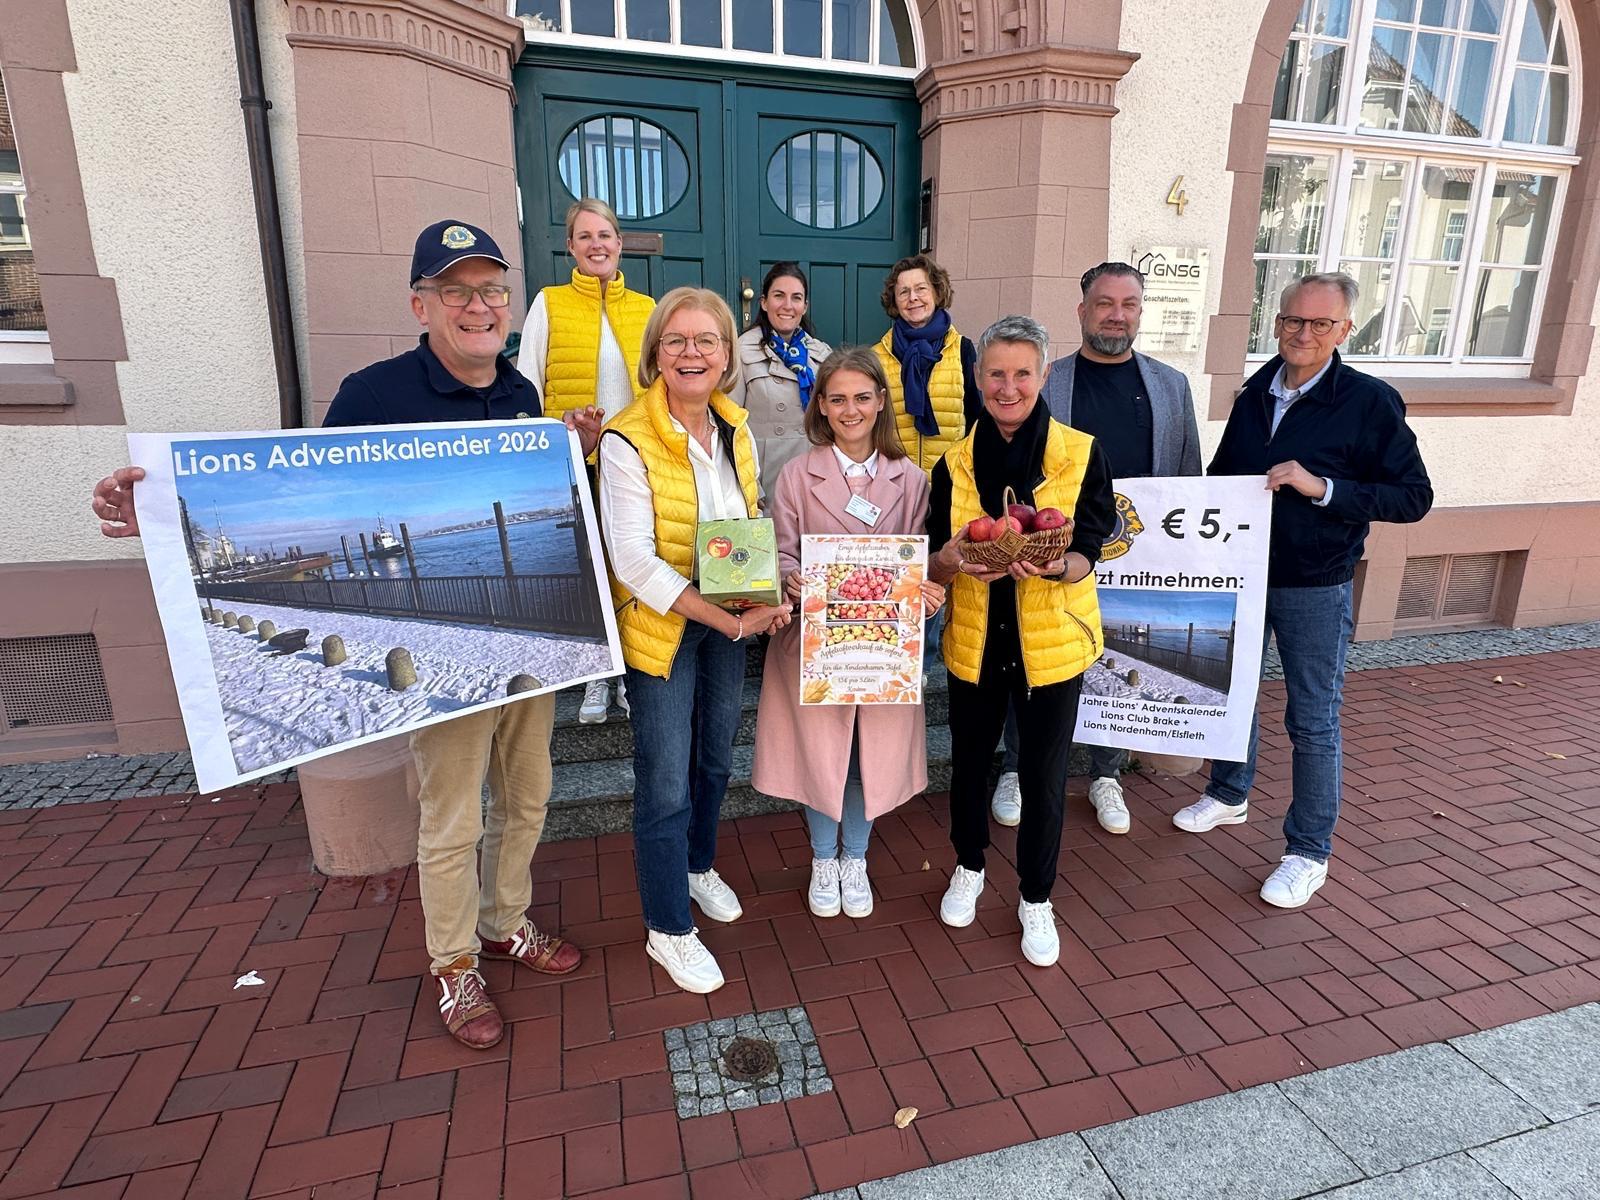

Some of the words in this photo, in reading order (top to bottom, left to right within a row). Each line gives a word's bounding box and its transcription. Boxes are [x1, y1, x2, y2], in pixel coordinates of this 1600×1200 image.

[1166, 175, 1188, 216] 4
[1154, 264, 1200, 278] GNSG
[174, 447, 257, 476] Lions
[267, 434, 493, 469] Adventskalender
[497, 430, 550, 454] 2026
[1161, 508, 1186, 539] €
[1120, 571, 1245, 589] mitnehmen:
[1082, 697, 1109, 708] Jahre
[1141, 703, 1227, 718] Adventskalender
[1101, 710, 1125, 721] Lions
[1127, 713, 1151, 723] Club
[1153, 717, 1181, 726] Brake
[1083, 720, 1107, 731] Lions
[1110, 723, 1205, 740] Nordenham/Elsfleth
